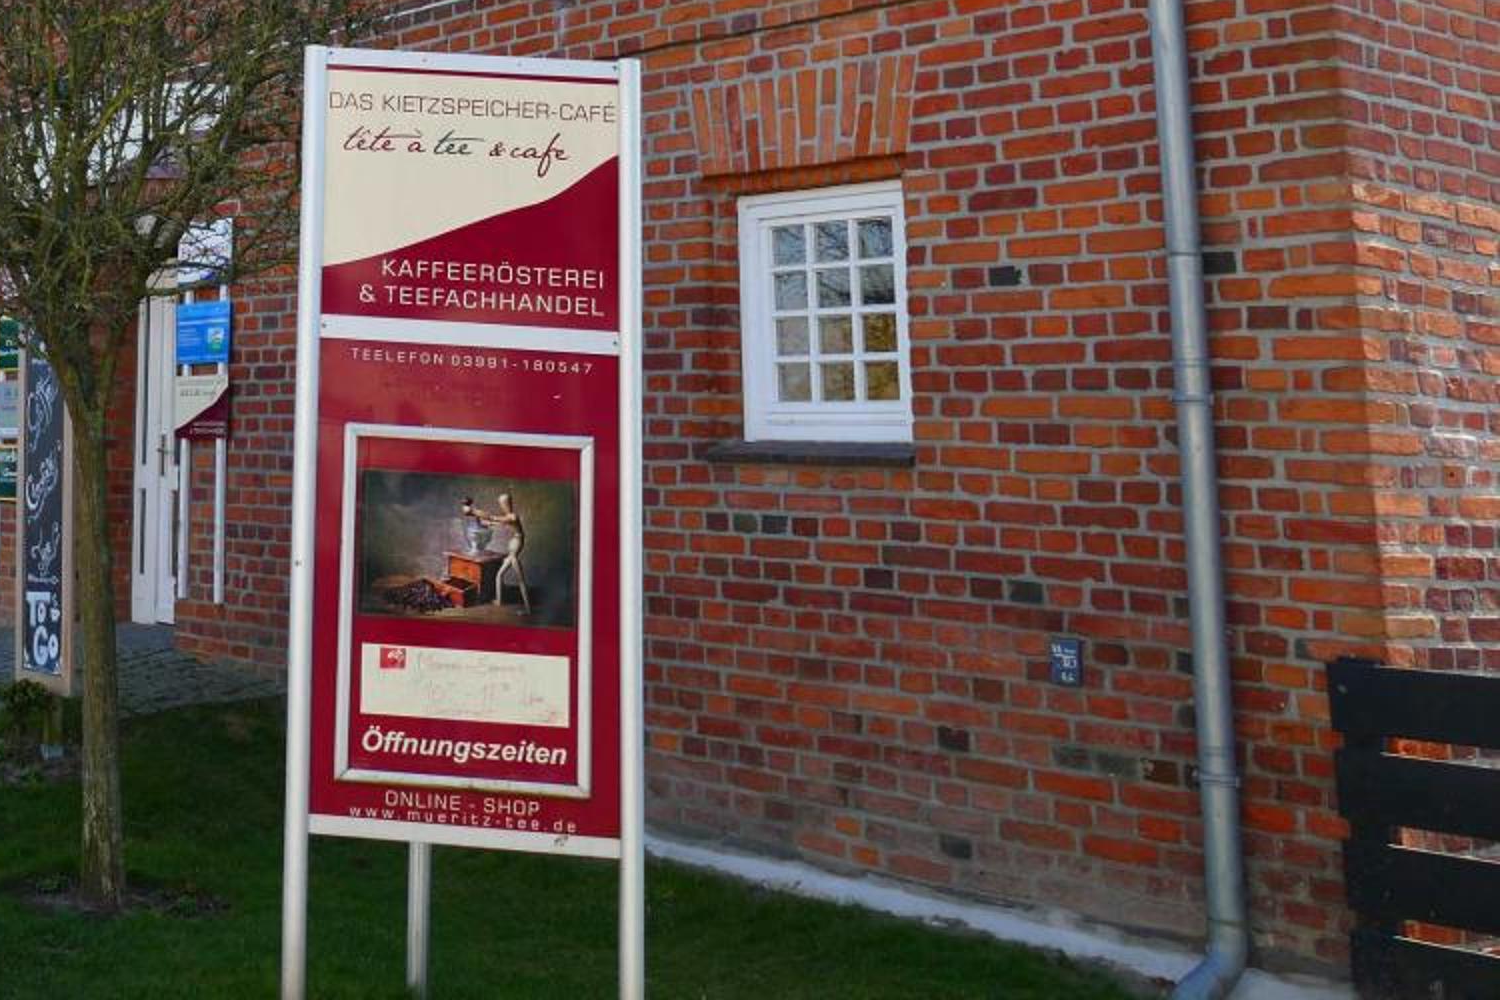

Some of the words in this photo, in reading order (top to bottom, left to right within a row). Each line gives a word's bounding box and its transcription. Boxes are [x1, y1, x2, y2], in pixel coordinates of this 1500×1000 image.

[328, 91, 373, 111] DAS
[382, 93, 617, 124] KIETZSPEICHER-CAFÉ
[433, 129, 483, 156] tee
[382, 258, 604, 290] KAFFEERÖSTEREI
[358, 283, 376, 303] &
[385, 284, 605, 317] TEEFACHHANDEL
[351, 347, 444, 365] TEELEFON
[361, 725, 568, 766] Öffnungszeiten
[384, 789, 461, 811] ONLINE
[483, 797, 541, 817] SHOP
[349, 805, 577, 833] www.mueritz-tee.de
